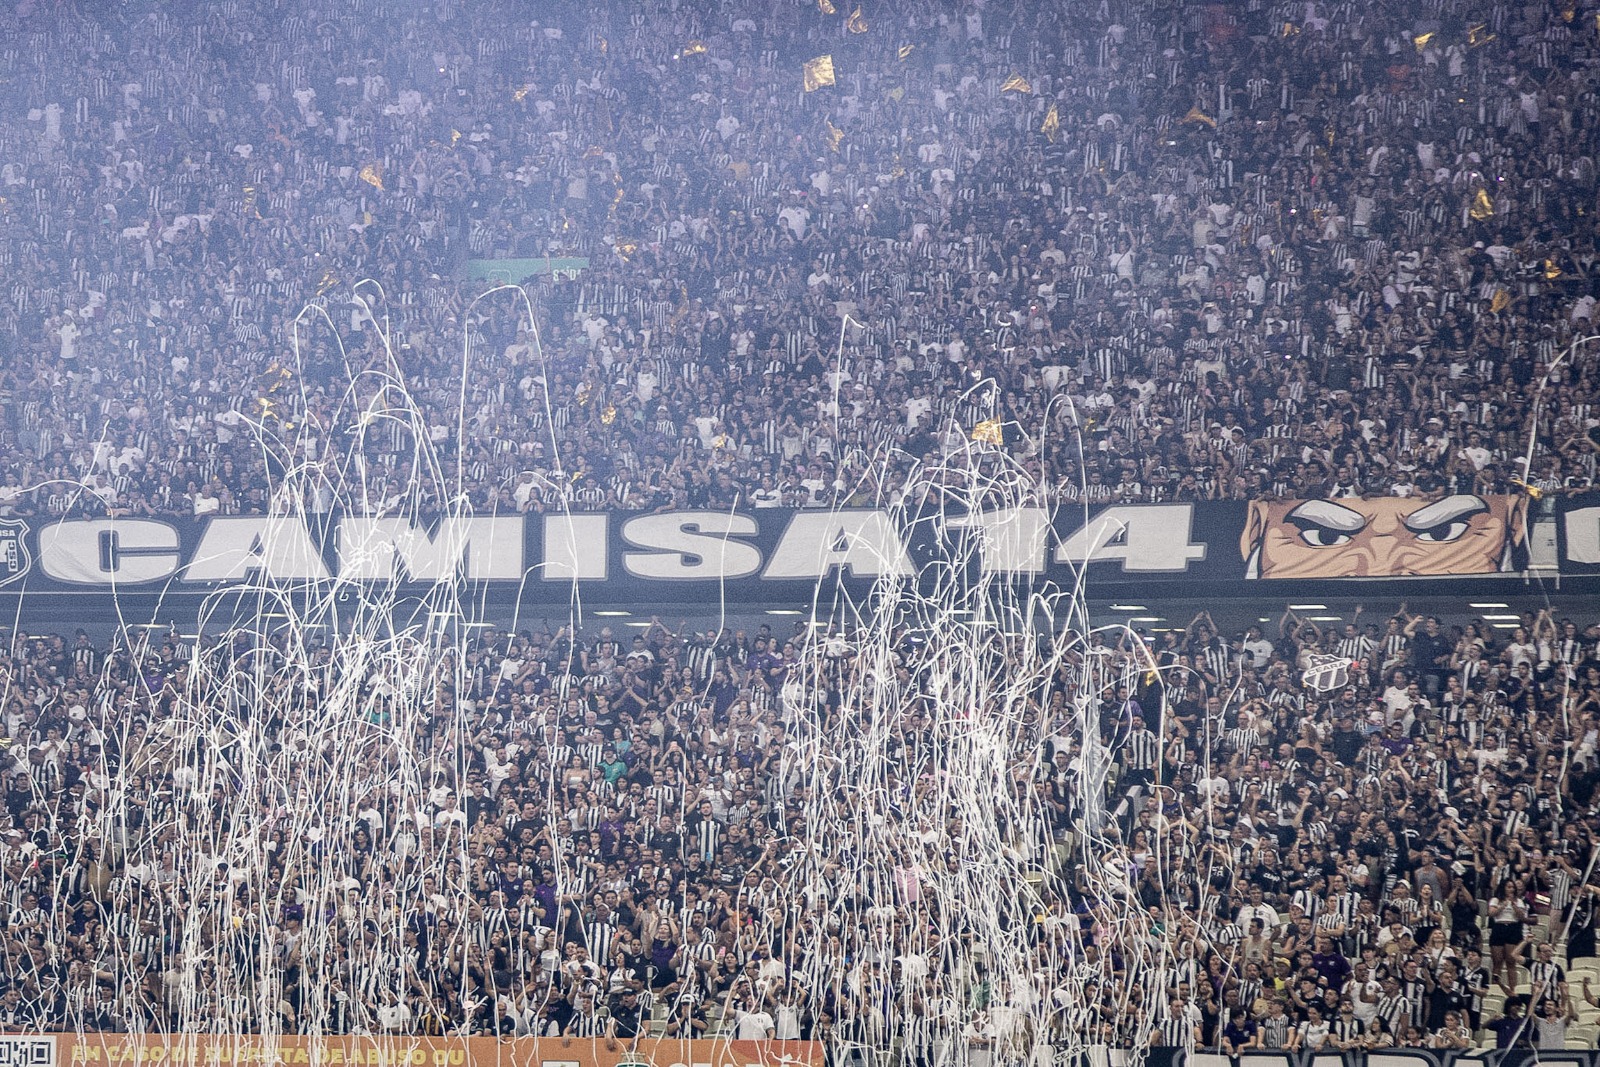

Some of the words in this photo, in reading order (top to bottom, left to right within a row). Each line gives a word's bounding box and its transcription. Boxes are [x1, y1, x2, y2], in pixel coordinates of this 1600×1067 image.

[39, 509, 918, 582] CAMISA
[943, 505, 1206, 573] 14
[108, 1046, 163, 1062] CASO
[205, 1047, 306, 1064] SUSPETA
[351, 1048, 427, 1066] ABUSO
[432, 1049, 465, 1066] OU
